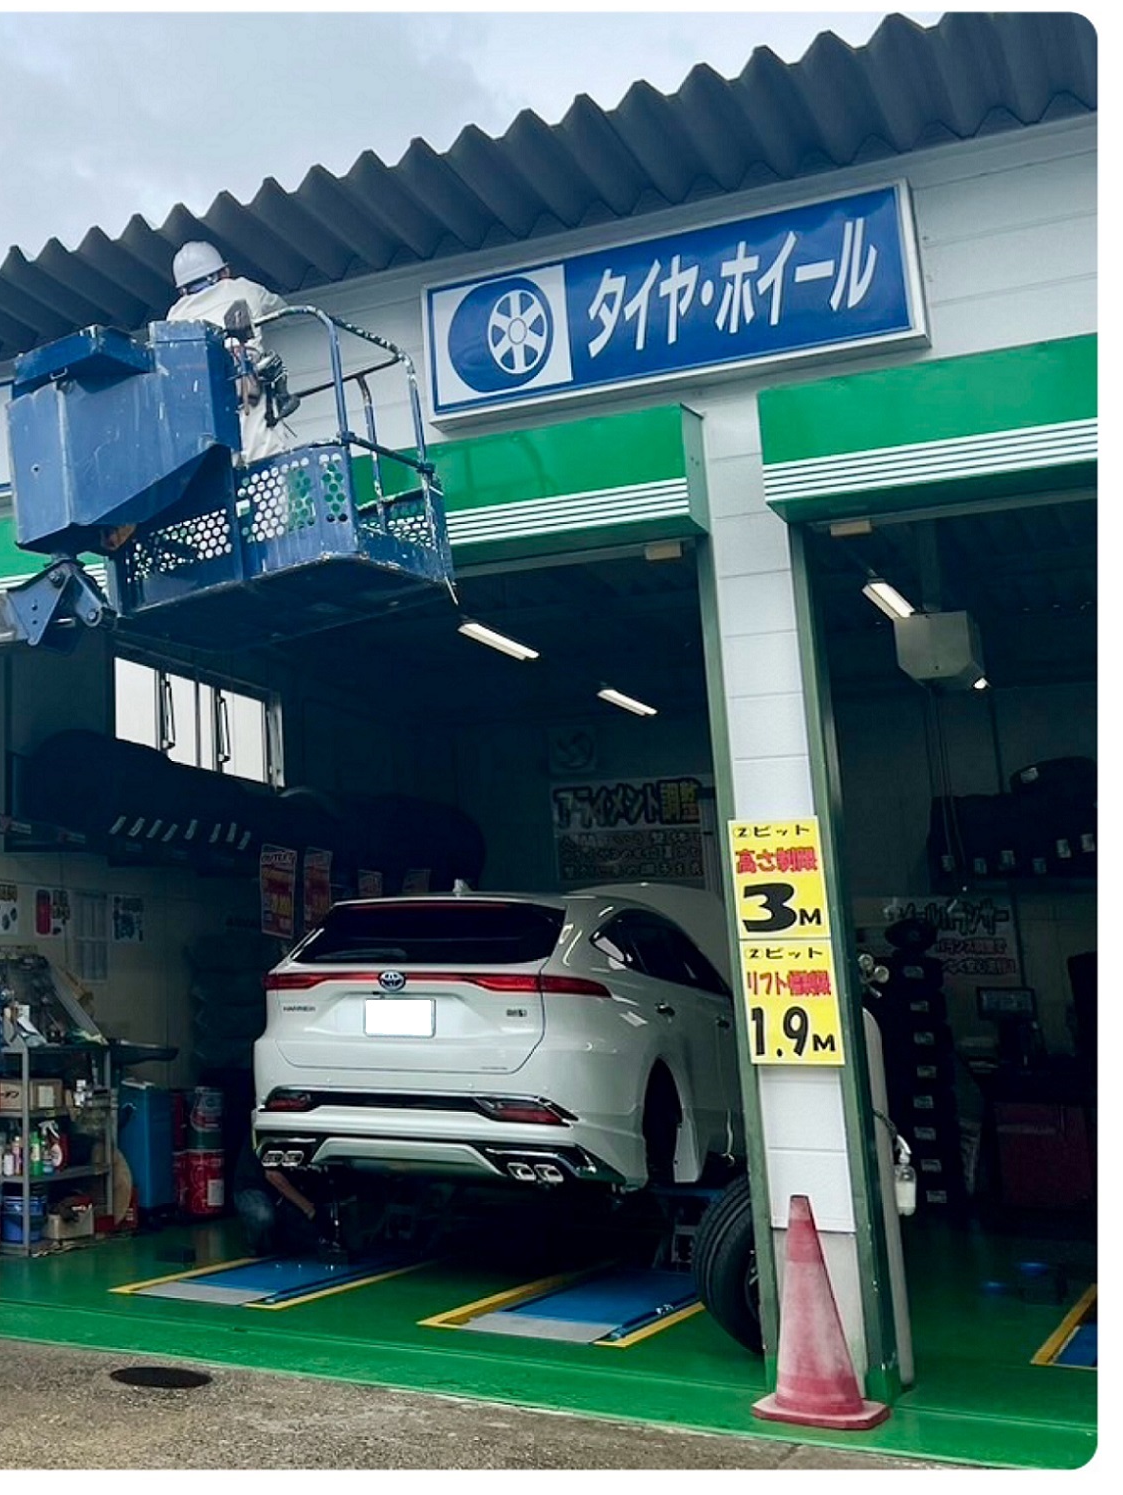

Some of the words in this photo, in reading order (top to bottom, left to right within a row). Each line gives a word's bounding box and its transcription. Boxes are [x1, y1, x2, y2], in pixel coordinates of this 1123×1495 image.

[588, 217, 877, 359] タイヤ・ホイール
[735, 846, 818, 874] 高さ制限
